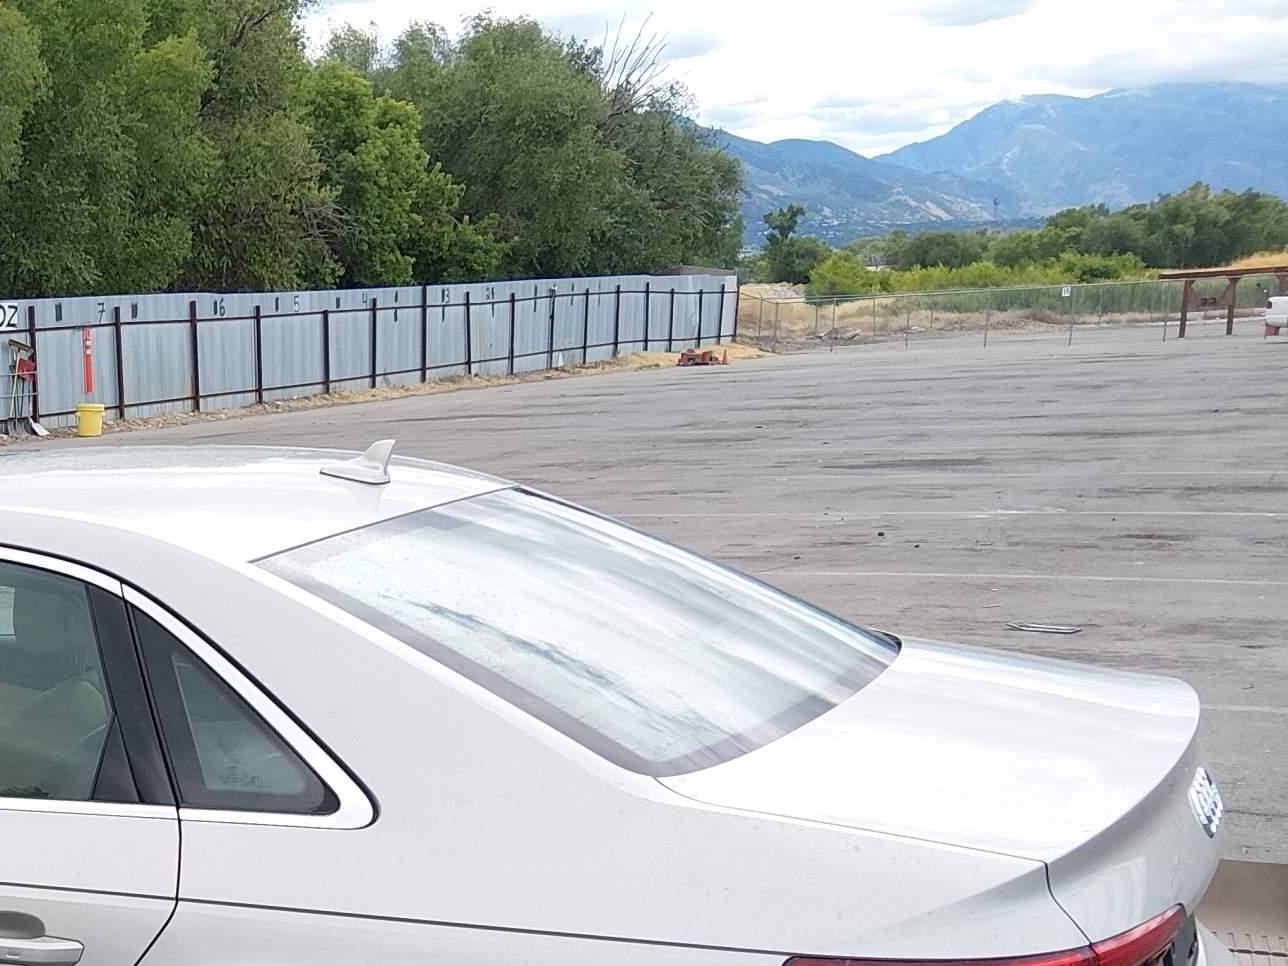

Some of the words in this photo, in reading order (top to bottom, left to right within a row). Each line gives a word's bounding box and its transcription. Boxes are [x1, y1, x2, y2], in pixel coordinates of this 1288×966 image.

[219, 297, 226, 316] 6
[293, 296, 300, 312] 5
[361, 291, 368, 310] 4
[96, 302, 106, 324] 7
